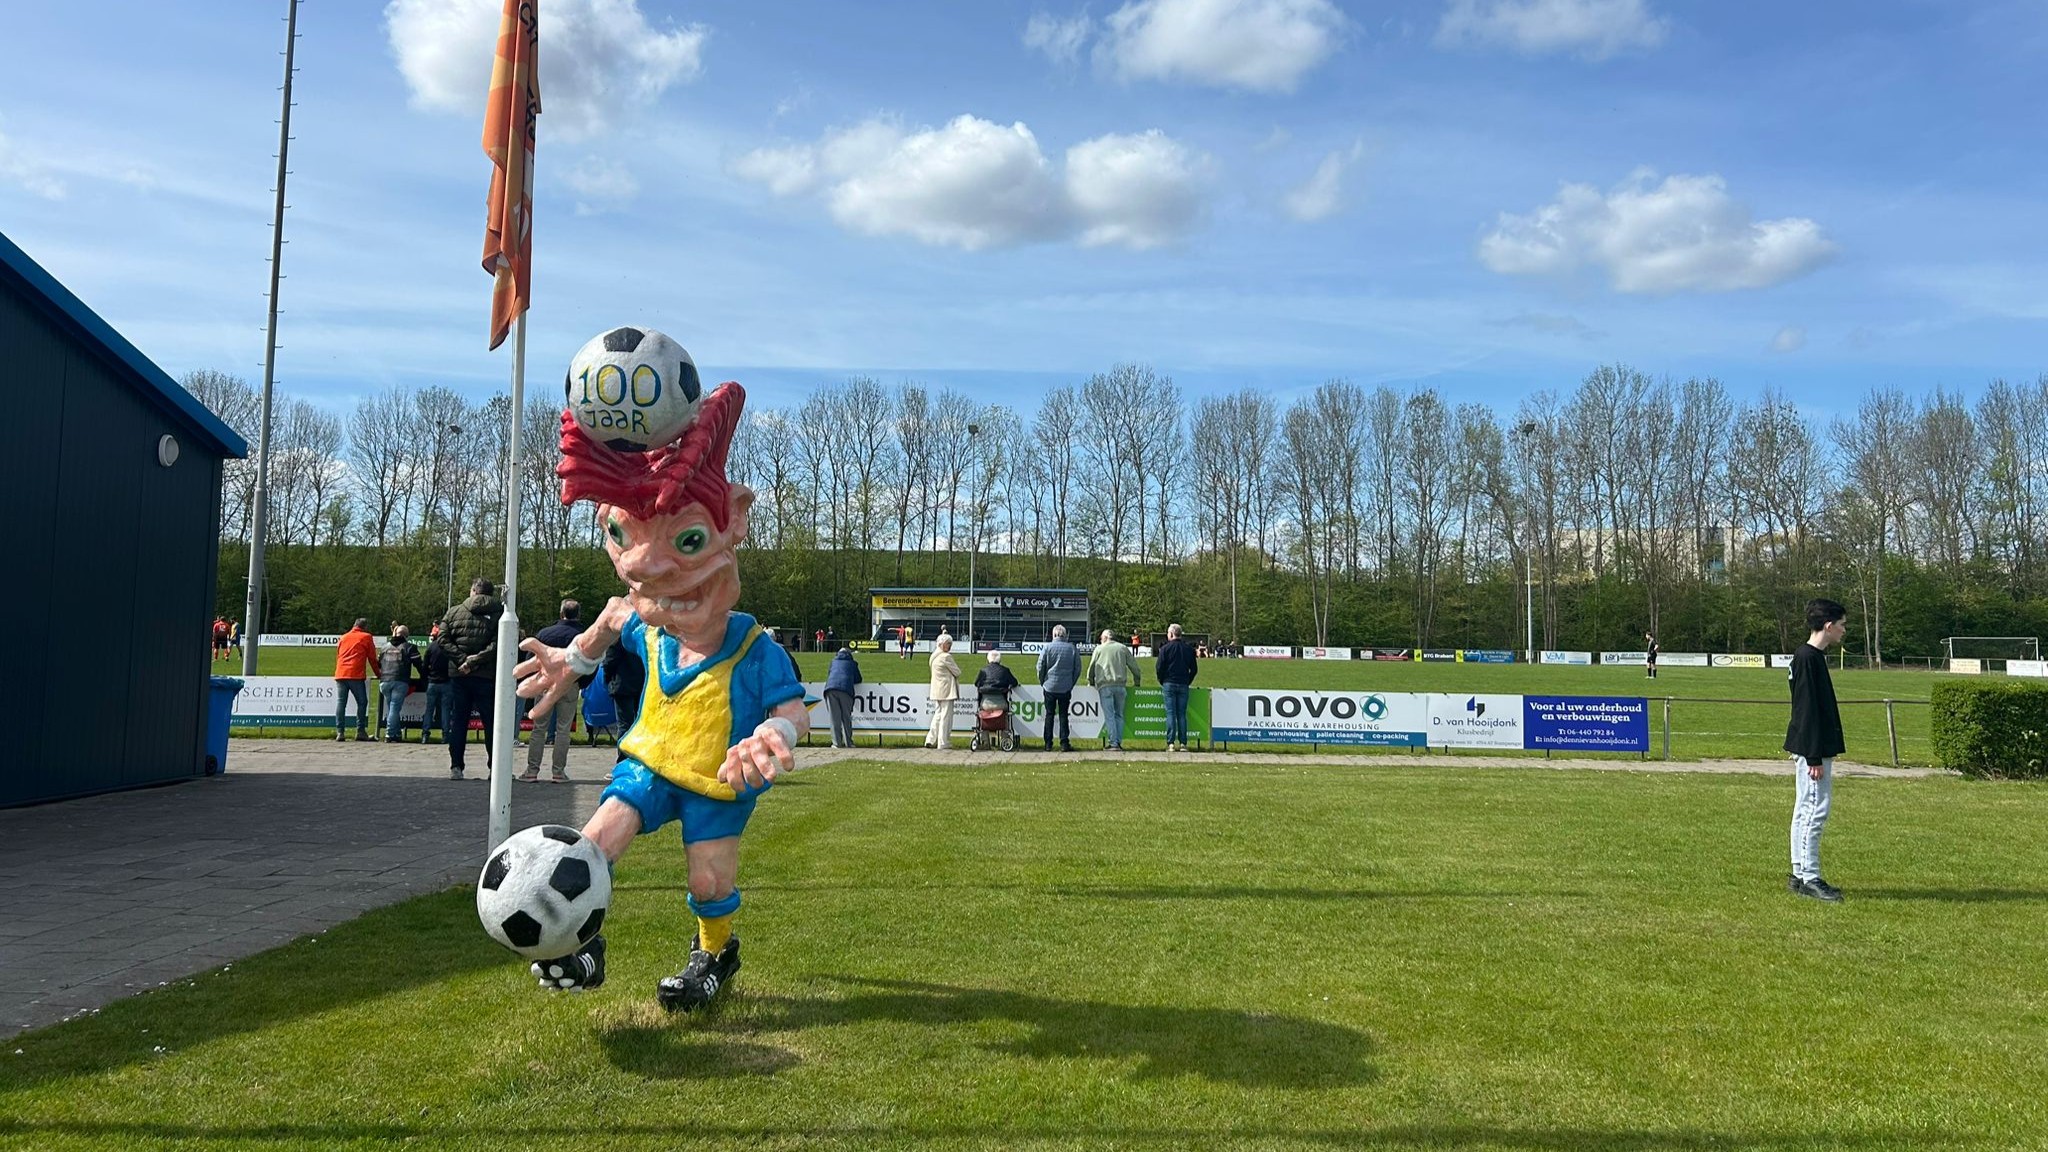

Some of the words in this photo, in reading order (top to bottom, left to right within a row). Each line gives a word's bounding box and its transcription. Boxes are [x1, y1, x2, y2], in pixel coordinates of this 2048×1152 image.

[579, 364, 661, 407] 100
[883, 596, 922, 604] Beerendonk
[1031, 598, 1049, 607] Groep
[407, 639, 427, 647] oken
[1022, 644, 1044, 652] CON
[243, 687, 333, 698] SCHEEPERS
[850, 690, 917, 714] ntus.
[1248, 695, 1356, 719] novo
[1530, 702, 1550, 711] Voor
[1556, 702, 1566, 711] al
[1586, 703, 1642, 713] onderhoud
[400, 714, 424, 722] YSTEMS
[1433, 717, 1443, 726] D.
[1466, 717, 1517, 728] Hooijdonk
[1557, 713, 1630, 723] verbouwingen
[1248, 721, 1299, 729] PACKAGING
[1312, 723, 1380, 731] WAREHOUSING
[1267, 731, 1309, 739] warehousing
[1316, 731, 1336, 739] pallet
[1336, 732, 1364, 740] cleaning
[1372, 733, 1409, 741] co-packing
